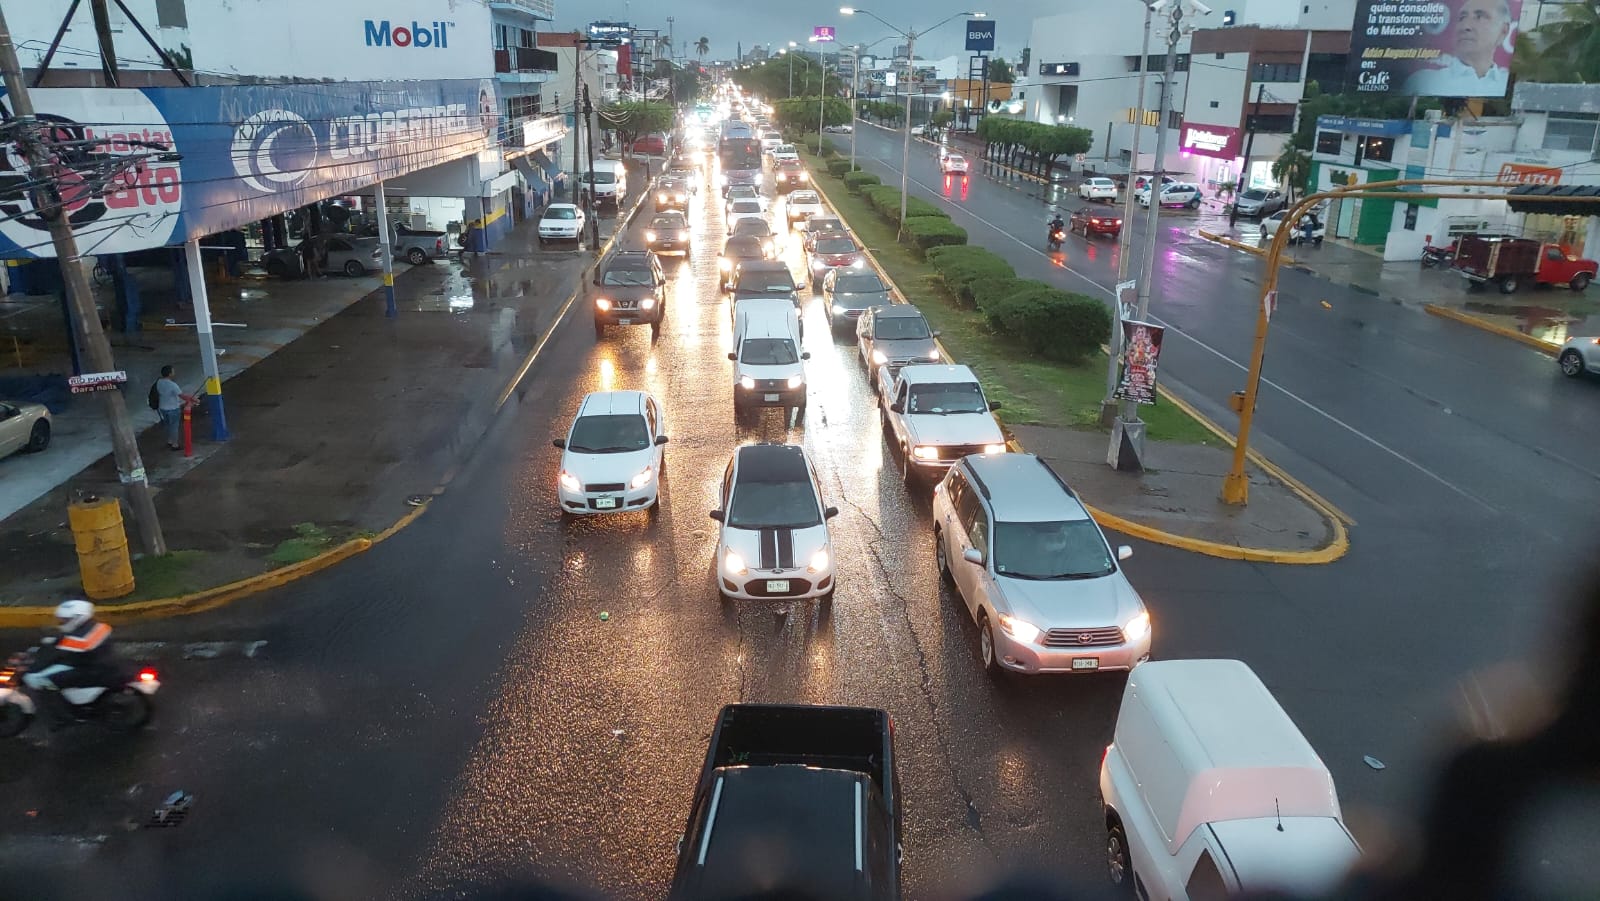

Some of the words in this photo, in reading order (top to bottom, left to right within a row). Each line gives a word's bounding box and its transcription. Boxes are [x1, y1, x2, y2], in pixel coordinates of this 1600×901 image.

[1370, 4, 1396, 14] quien
[1399, 3, 1444, 13] consolide
[1368, 14, 1376, 24] la
[1378, 13, 1444, 24] transformación
[969, 31, 993, 40] BBVA
[1366, 26, 1379, 35] de
[1383, 48, 1417, 59] Augusto
[1361, 60, 1377, 69] en:
[1359, 71, 1390, 85] Café
[1357, 84, 1390, 92] MILENIO
